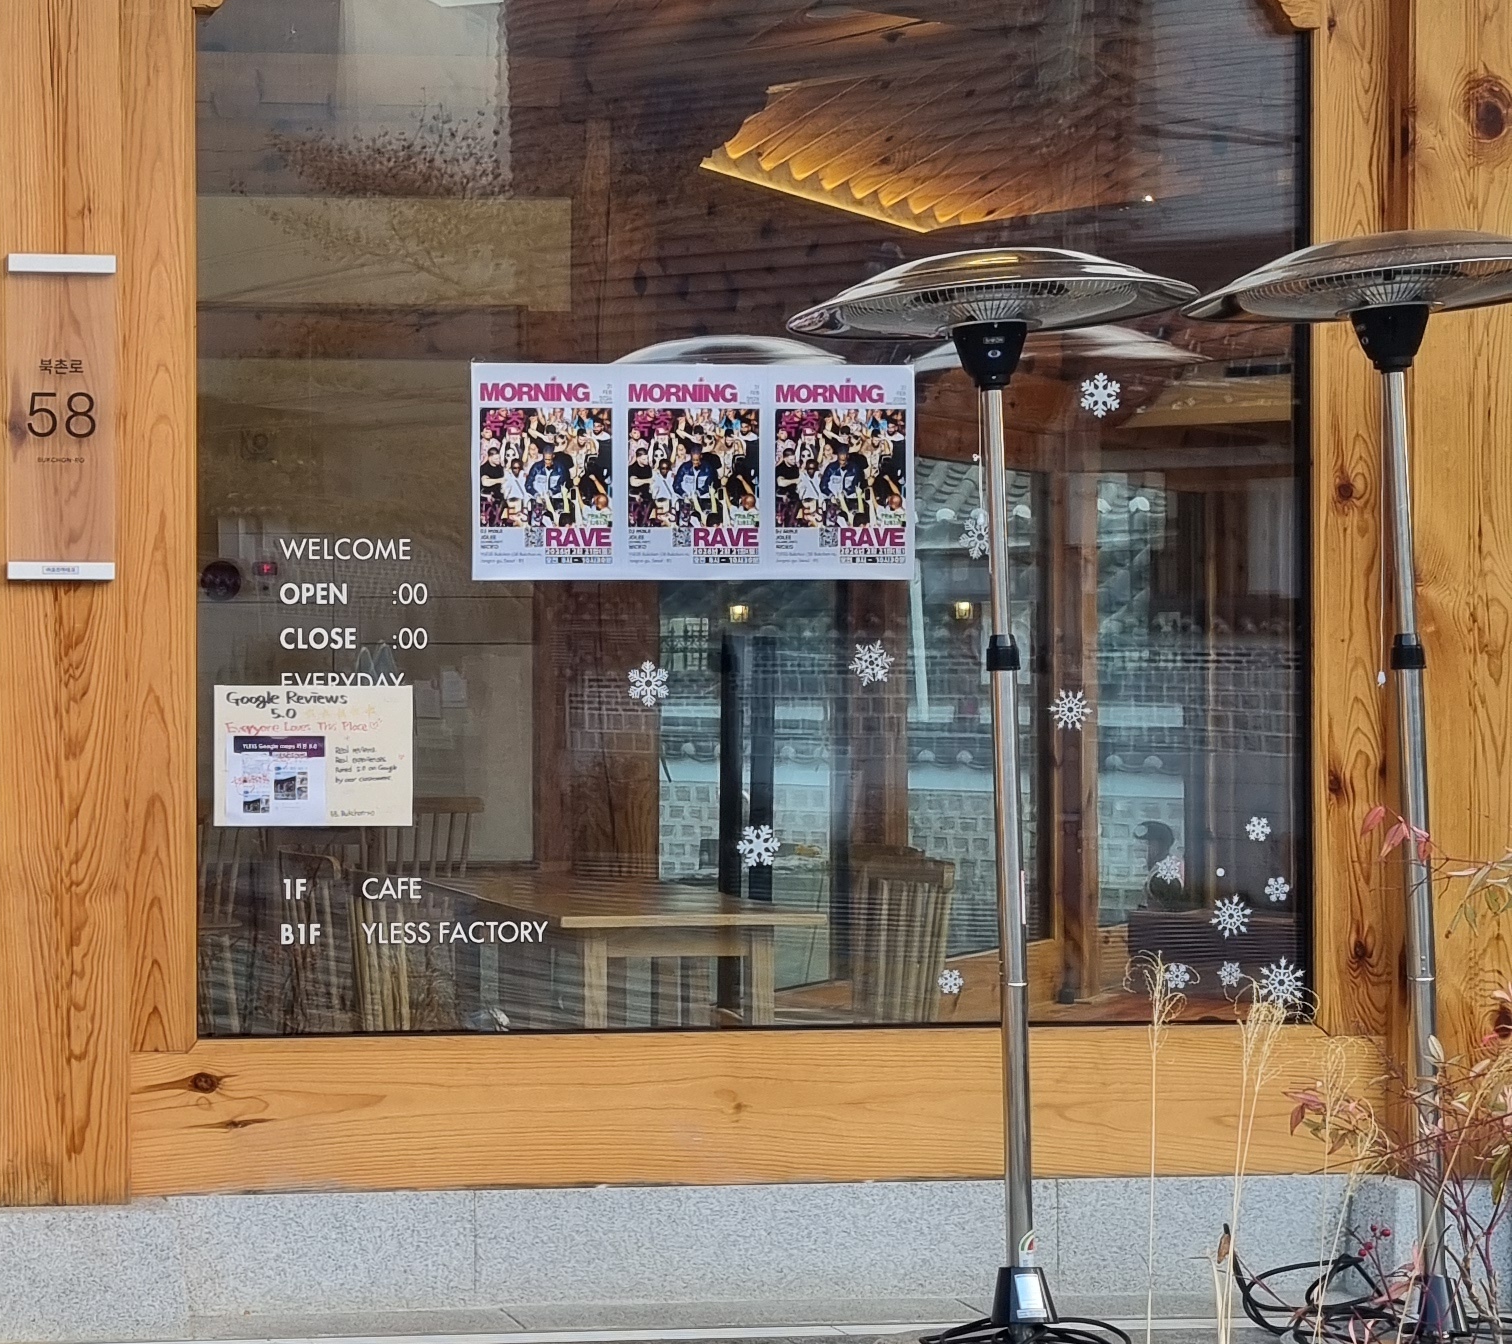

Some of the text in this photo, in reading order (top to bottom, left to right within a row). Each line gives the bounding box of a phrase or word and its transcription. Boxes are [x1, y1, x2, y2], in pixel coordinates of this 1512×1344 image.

[39, 359, 84, 375] 북촌로
[27, 392, 96, 438] 58
[546, 528, 612, 547] RAVE
[693, 528, 759, 547] RAVE
[840, 528, 905, 547] RAVE
[280, 538, 411, 560] WELCOME
[280, 583, 428, 605] OPEN :00
[280, 627, 428, 650] CLOSE :00
[226, 690, 348, 709] Google Reviews
[271, 708, 297, 719] 5.0
[283, 878, 422, 900] 1F CAFE
[280, 920, 549, 945] B1F YLESS FACTORY
